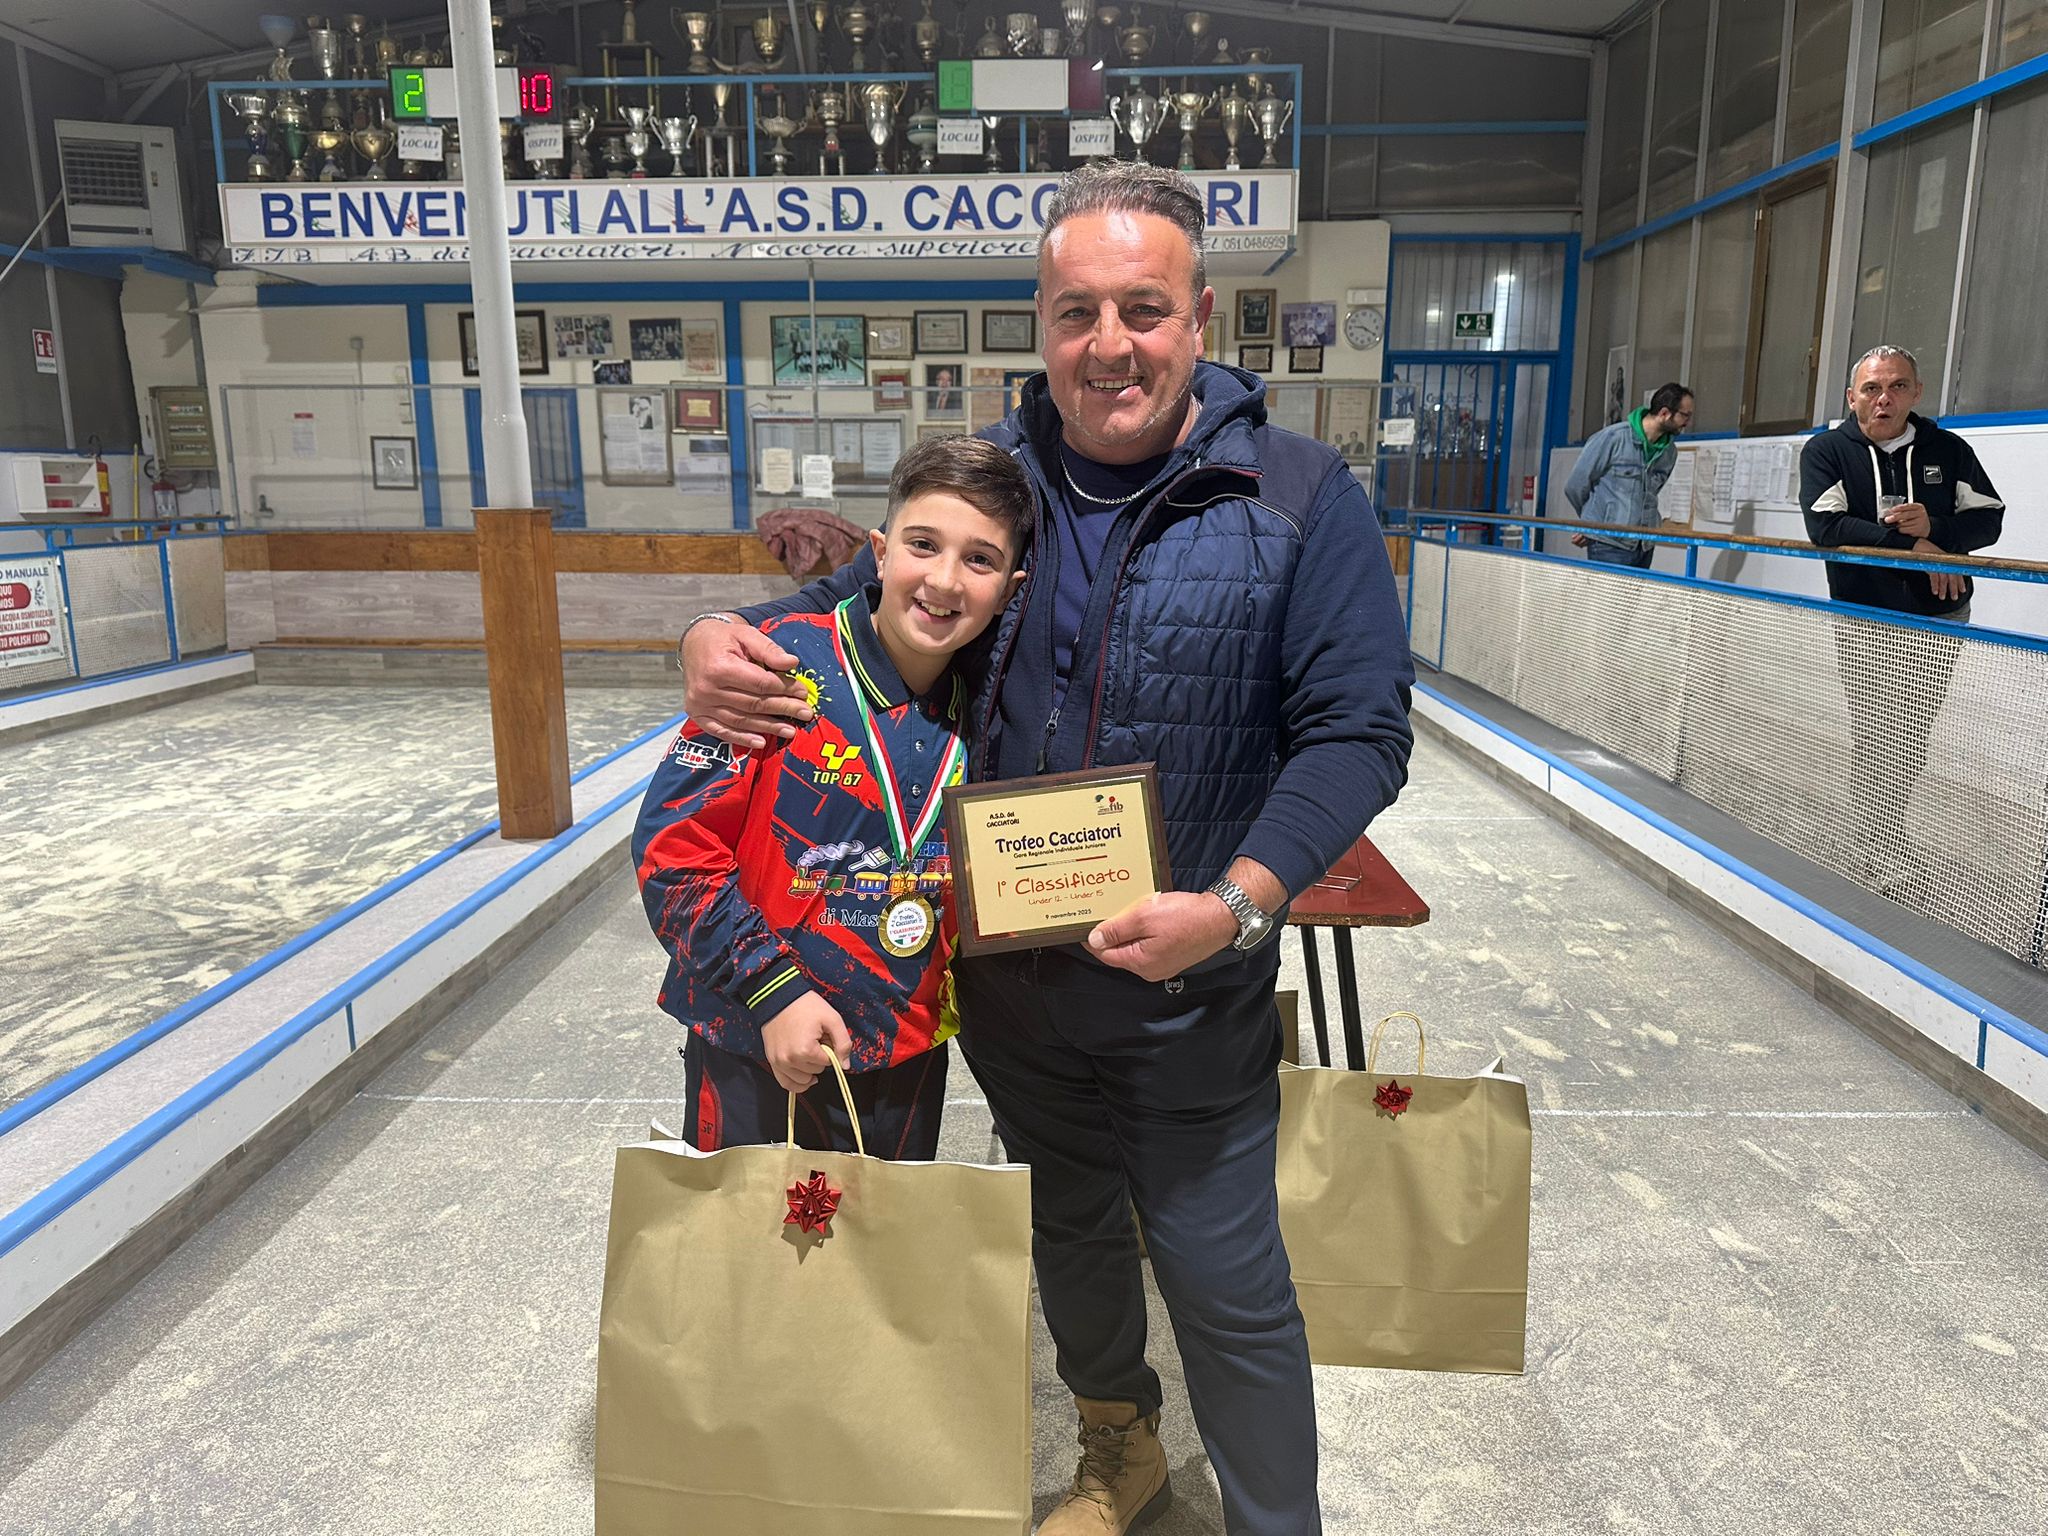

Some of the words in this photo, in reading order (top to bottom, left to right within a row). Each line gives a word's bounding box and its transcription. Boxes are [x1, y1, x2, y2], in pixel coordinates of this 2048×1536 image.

[404, 74, 423, 112] 2
[521, 73, 553, 112] 10
[402, 138, 439, 149] LOCALI
[528, 137, 558, 148] OSPITI
[941, 132, 980, 142] LOCALI
[1075, 133, 1109, 143] OSPITI
[5, 567, 49, 579] MANUALE
[9, 635, 31, 648] POLISH
[813, 770, 842, 785] TOP
[843, 772, 863, 786] 87
[989, 812, 1005, 820] A.S.D.
[986, 818, 1020, 828] CACCIATORI
[995, 835, 1045, 854] Trofeo
[1049, 823, 1122, 847] Cacciatori
[1028, 849, 1054, 858] Regionale
[1055, 845, 1083, 854] Individuale
[1084, 842, 1106, 850] Juniores
[1015, 868, 1130, 895] Classificato
[1028, 897, 1053, 906] Under
[1070, 890, 1094, 900] Under
[1095, 888, 1104, 897] 15
[818, 908, 836, 926] di
[839, 908, 880, 928] Mas
[1050, 911, 1077, 920] novembre
